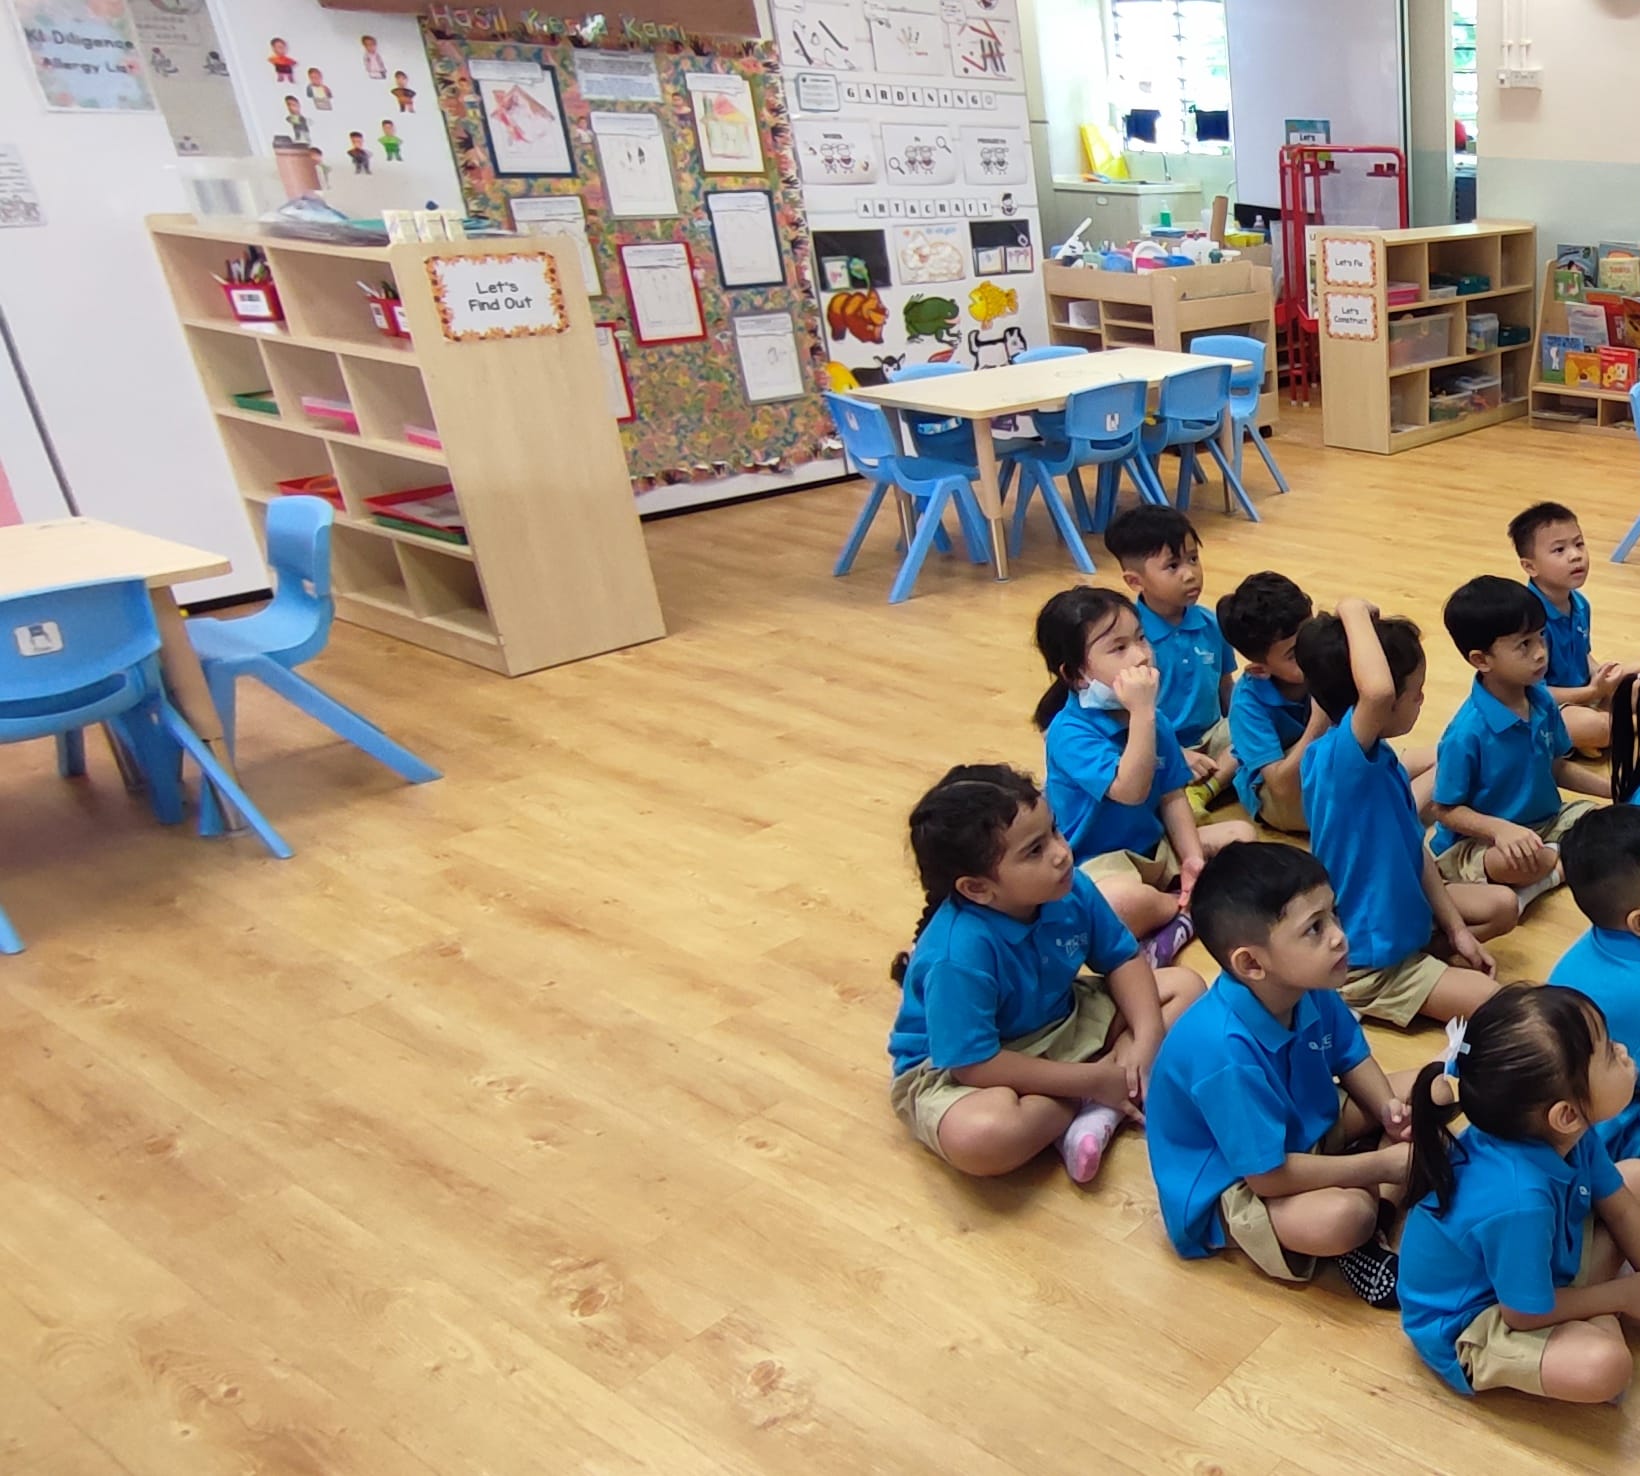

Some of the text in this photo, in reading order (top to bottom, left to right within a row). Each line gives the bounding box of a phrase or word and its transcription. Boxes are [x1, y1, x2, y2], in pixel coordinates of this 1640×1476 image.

[619, 13, 687, 40] Kami
[475, 281, 519, 295] Let's
[468, 296, 533, 312] Find Out
